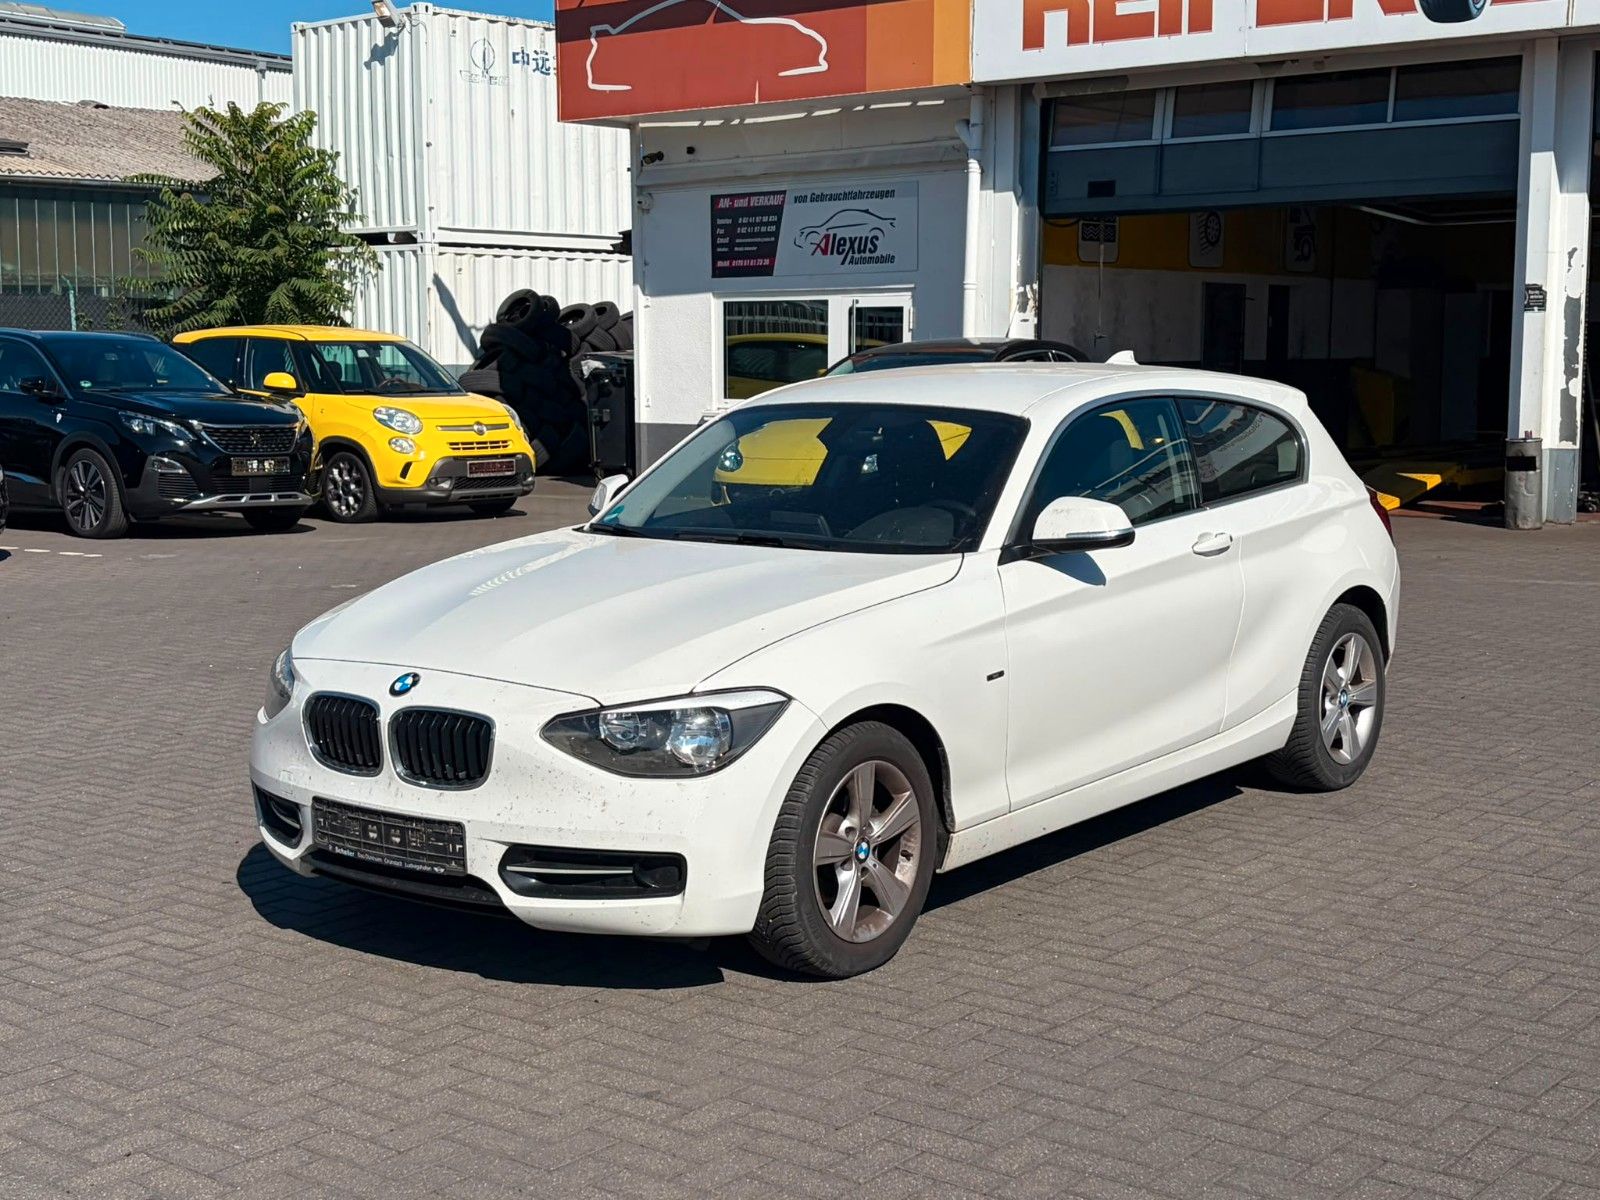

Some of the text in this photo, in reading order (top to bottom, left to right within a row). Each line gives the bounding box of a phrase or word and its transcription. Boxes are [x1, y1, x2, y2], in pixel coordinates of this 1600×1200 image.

[512, 46, 557, 77] 中远
[734, 197, 749, 208] und
[750, 195, 785, 206] VERKAUF
[794, 189, 896, 204] von Gebrauchtfahrzeugen
[811, 233, 879, 266] Alexus
[848, 254, 896, 266] Automobile
